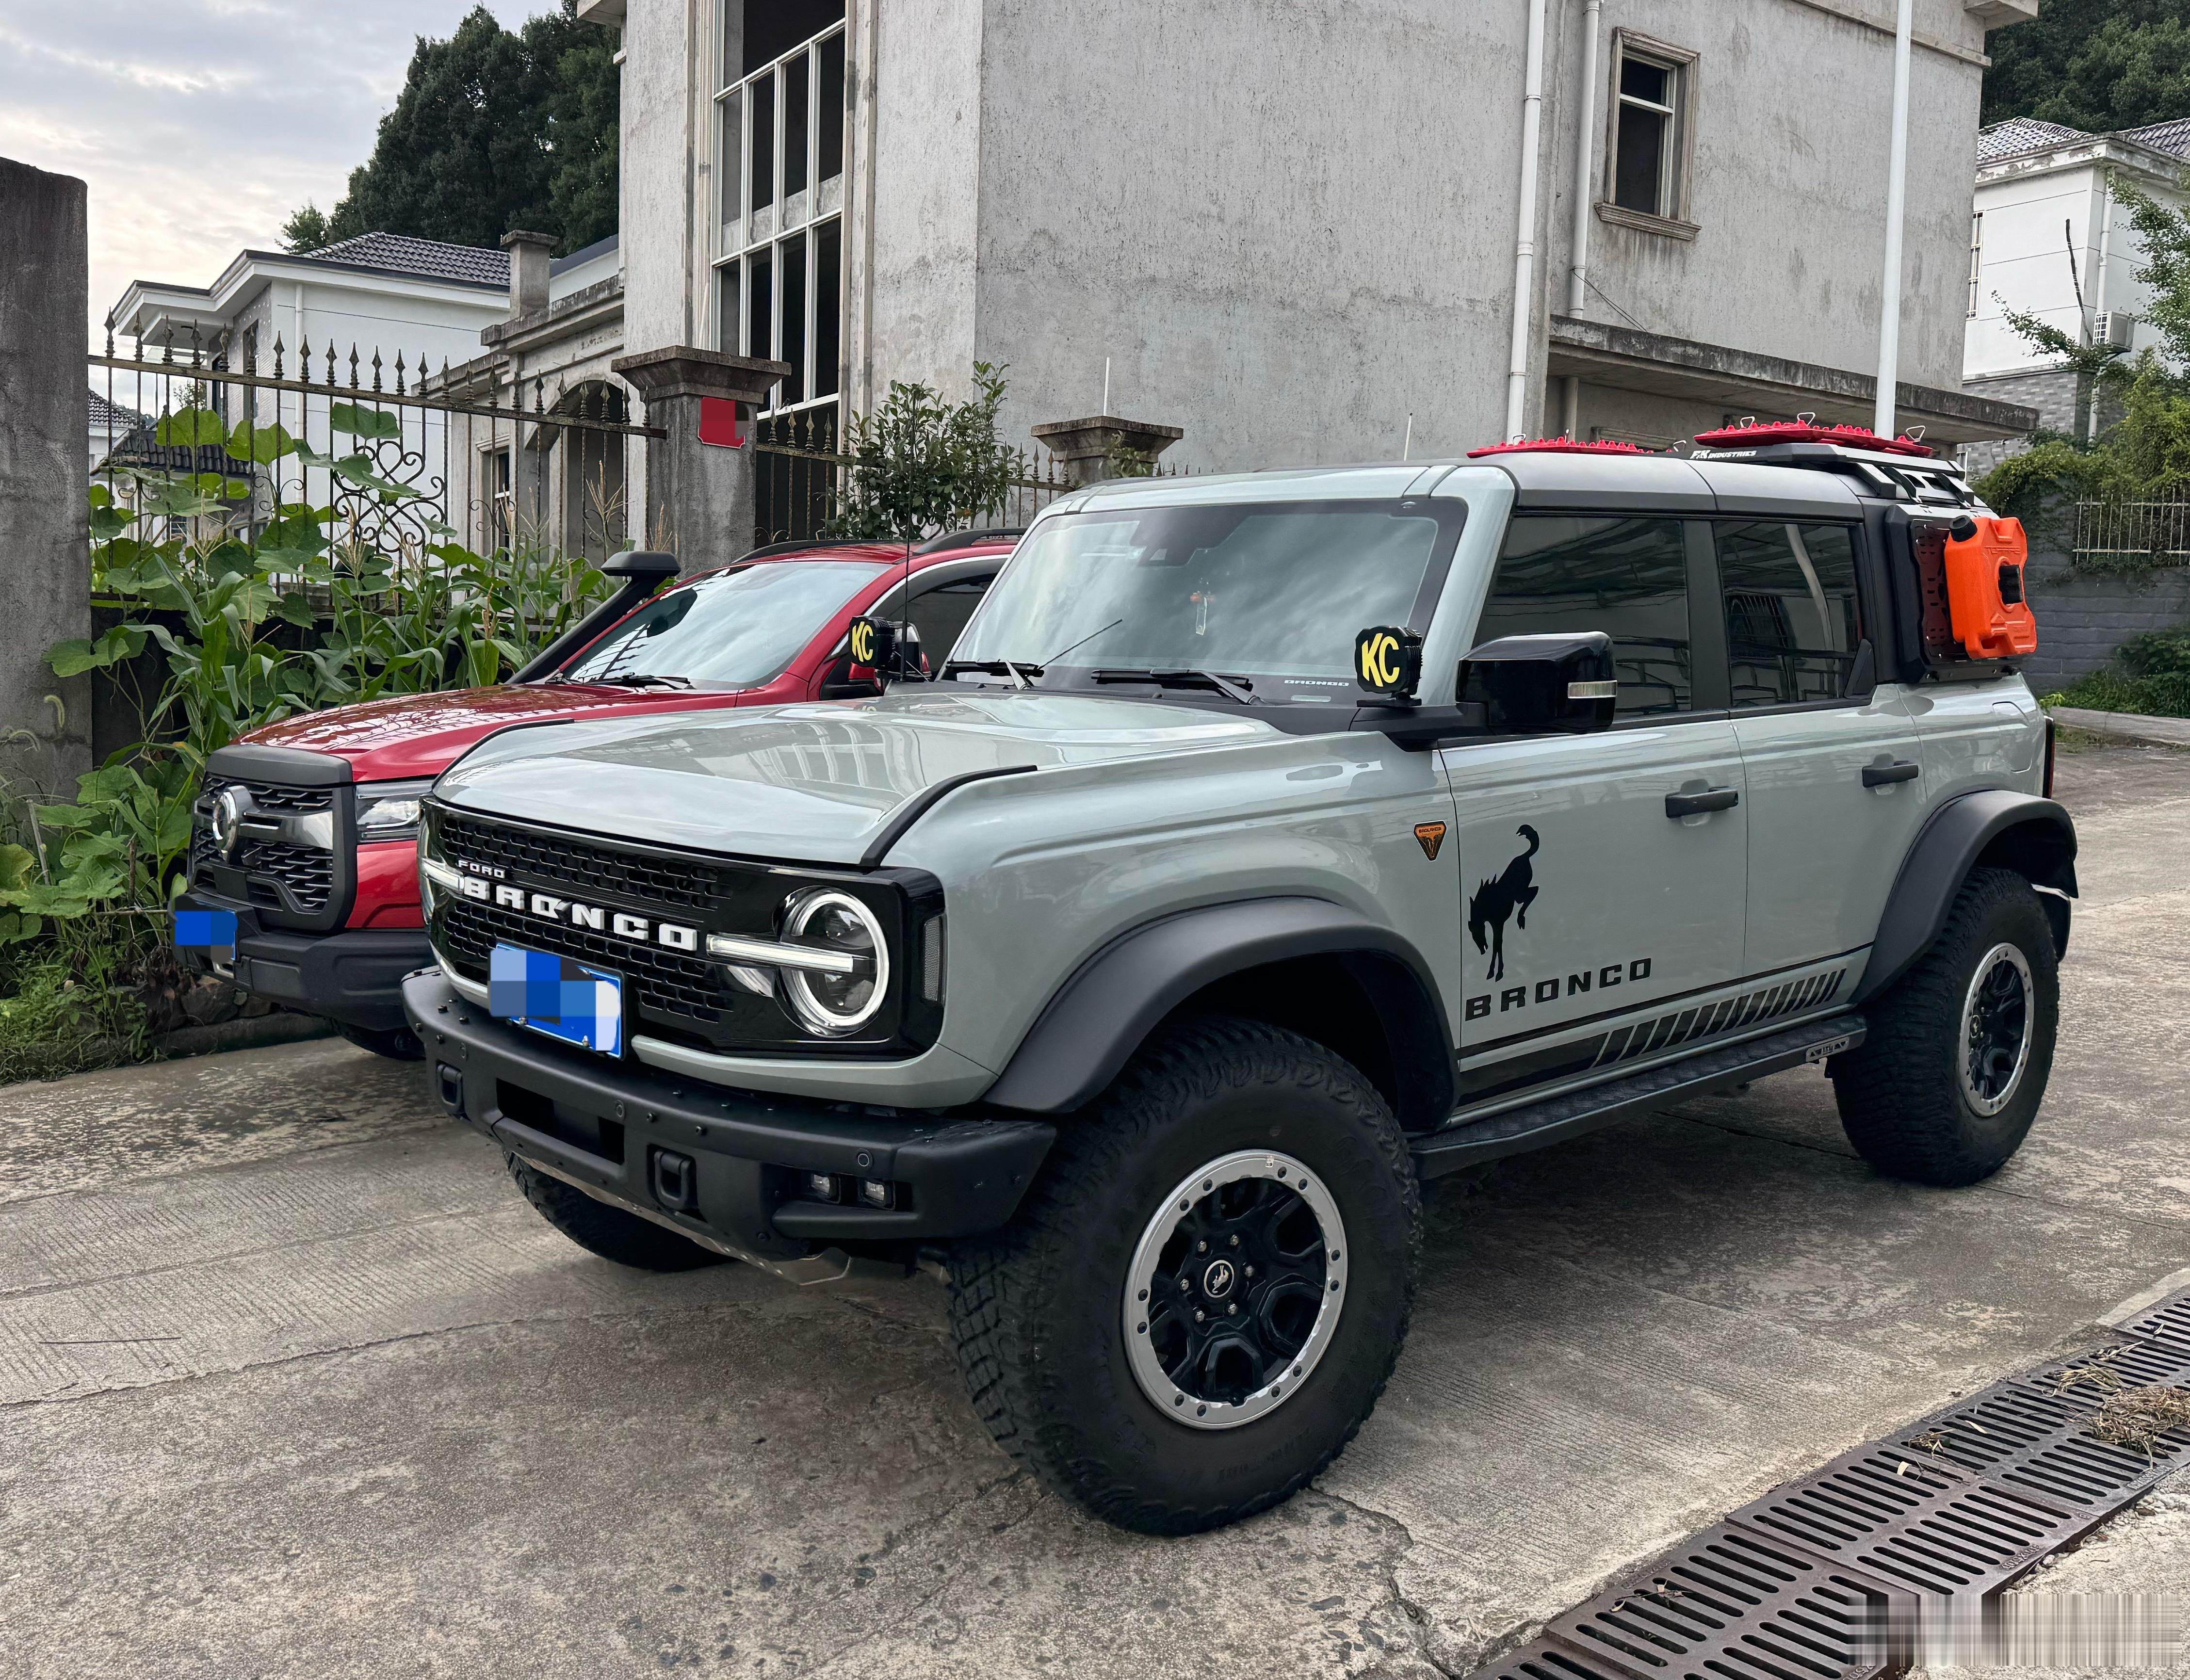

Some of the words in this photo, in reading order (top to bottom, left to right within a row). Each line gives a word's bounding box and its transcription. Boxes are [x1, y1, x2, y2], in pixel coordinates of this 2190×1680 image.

[1708, 451, 1757, 459] INDUSTRIES
[852, 621, 873, 662] KC
[1362, 632, 1400, 687] KC
[458, 860, 505, 878] FORD
[463, 876, 698, 951] BRONCO
[1465, 958, 1652, 1021] BRONCO
